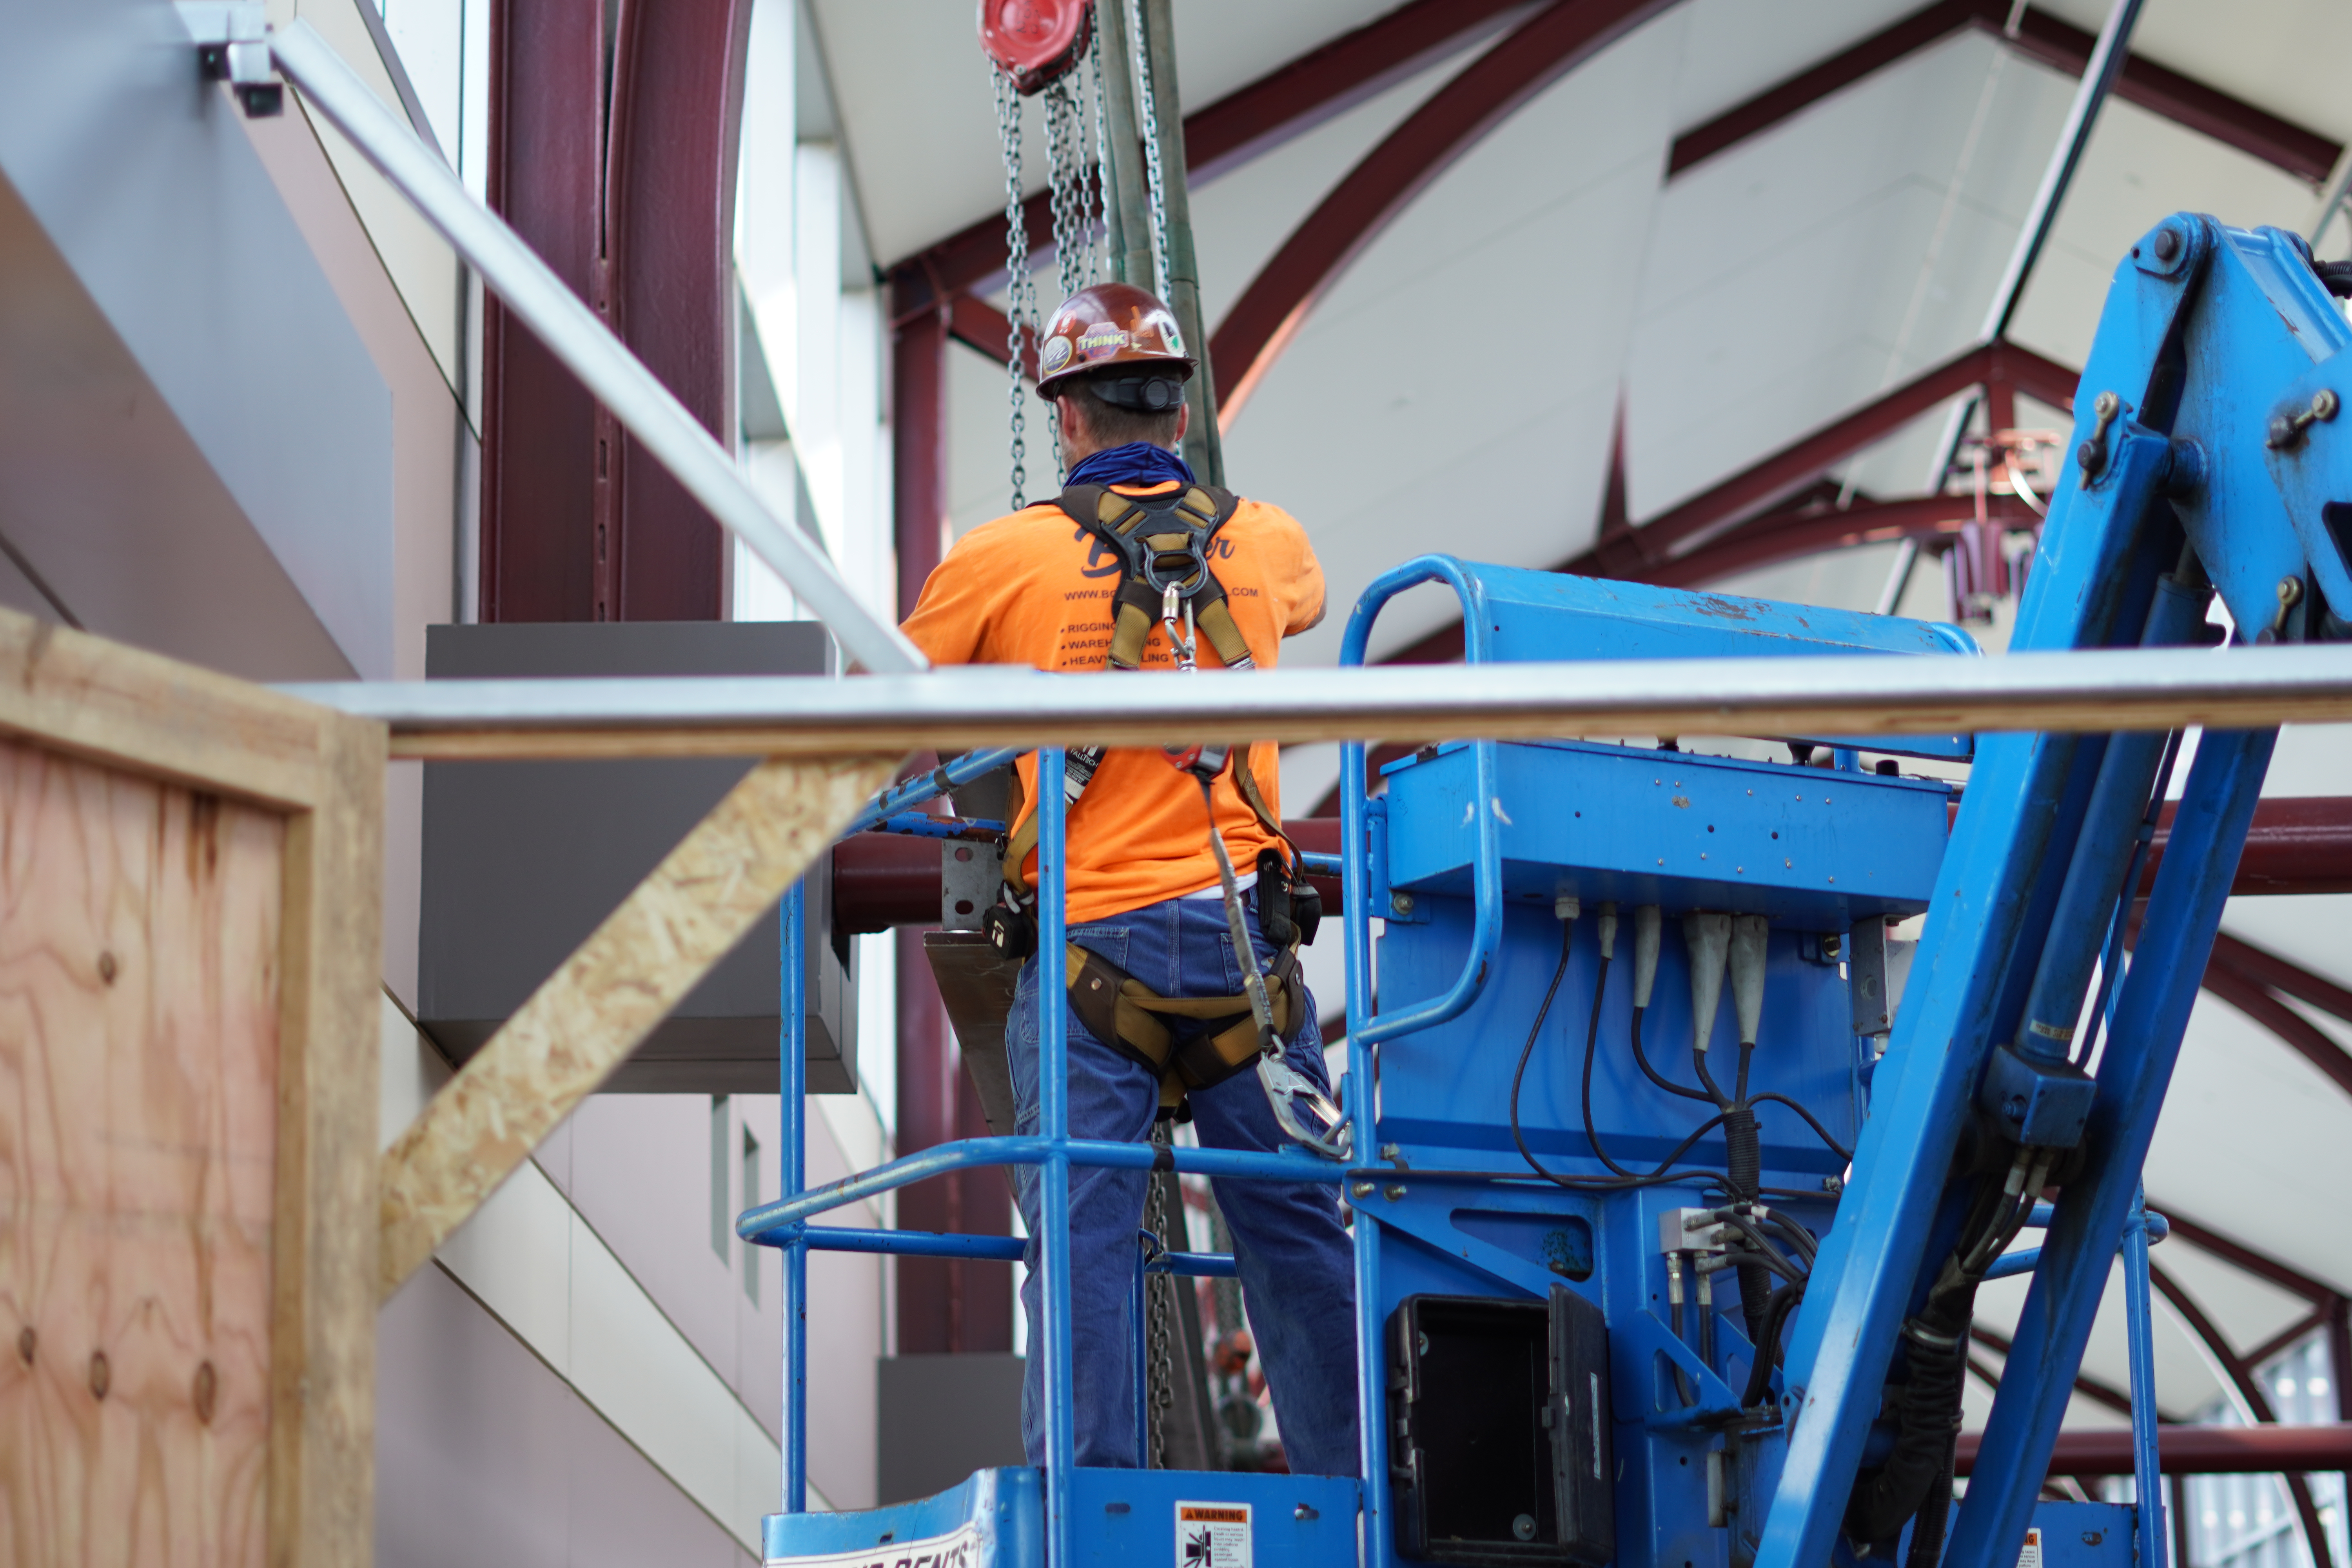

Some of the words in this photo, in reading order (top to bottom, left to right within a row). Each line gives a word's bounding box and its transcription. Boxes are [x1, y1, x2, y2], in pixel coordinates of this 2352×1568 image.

[1079, 334, 1125, 350] THINK
[1068, 638, 1161, 650] WAREHNG
[1194, 1509, 1243, 1521] WARNING
